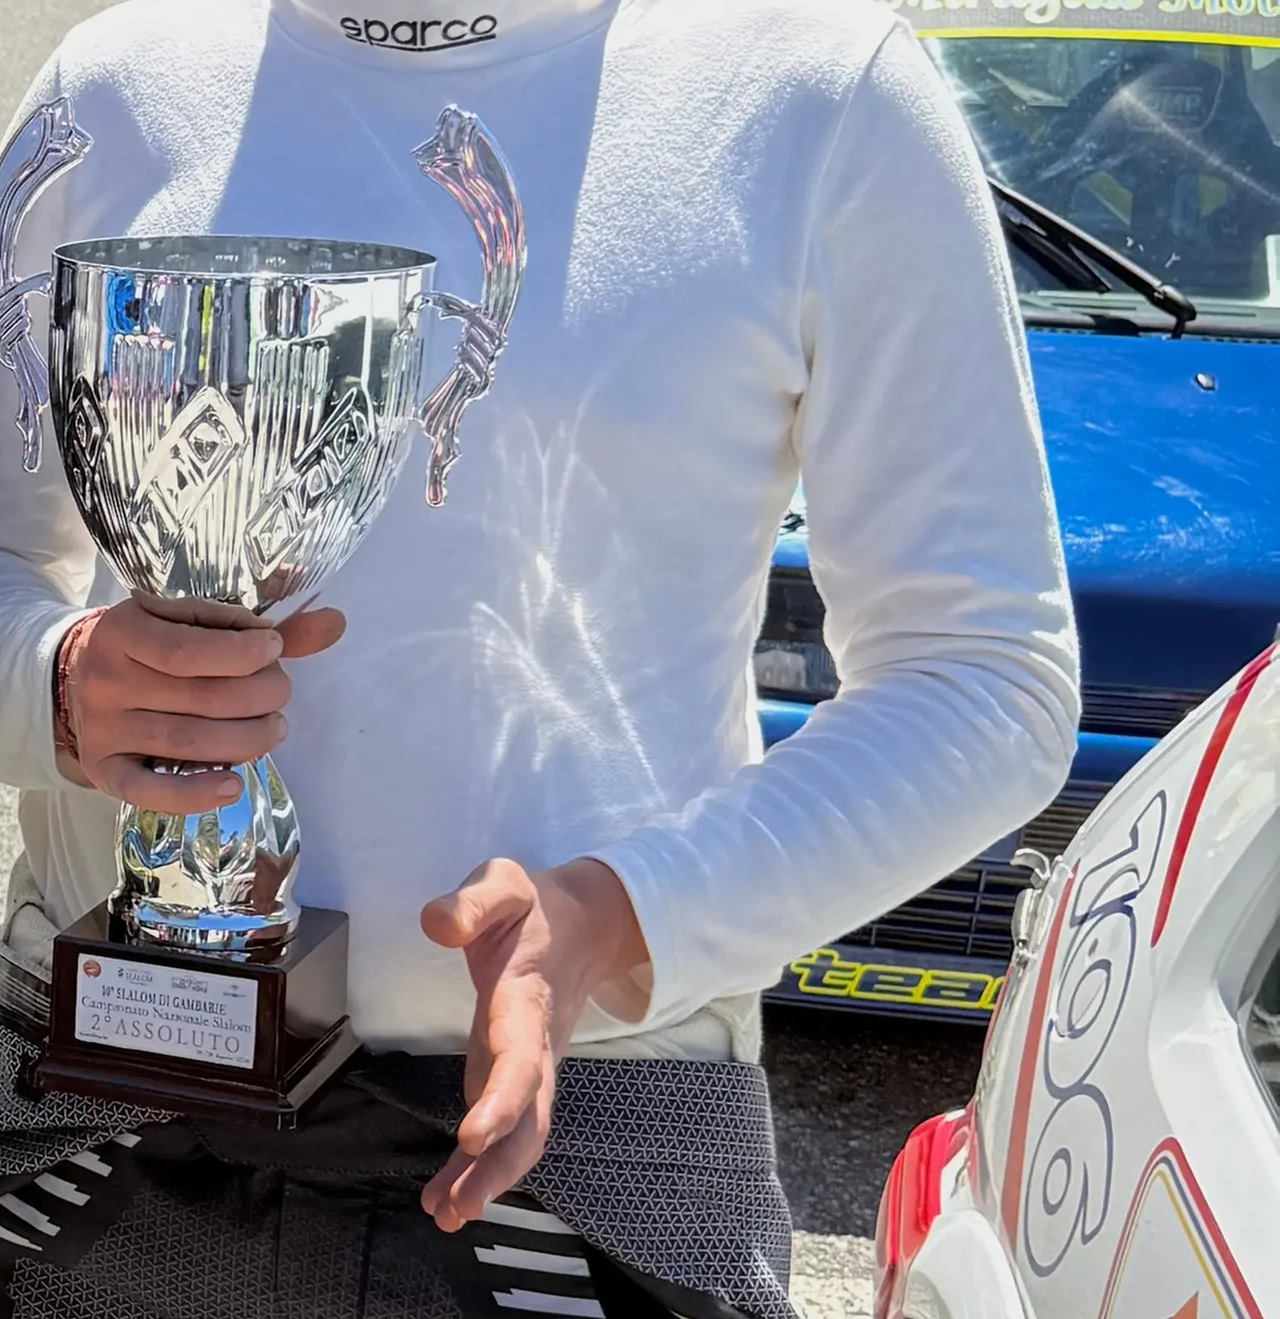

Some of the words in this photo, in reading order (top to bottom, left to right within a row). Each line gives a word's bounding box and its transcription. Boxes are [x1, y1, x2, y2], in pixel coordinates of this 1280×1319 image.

[340, 14, 498, 52] sparco
[791, 948, 1008, 1010] tea
[158, 994, 170, 1008] DI
[115, 1018, 241, 1054] ASSOLUTO
